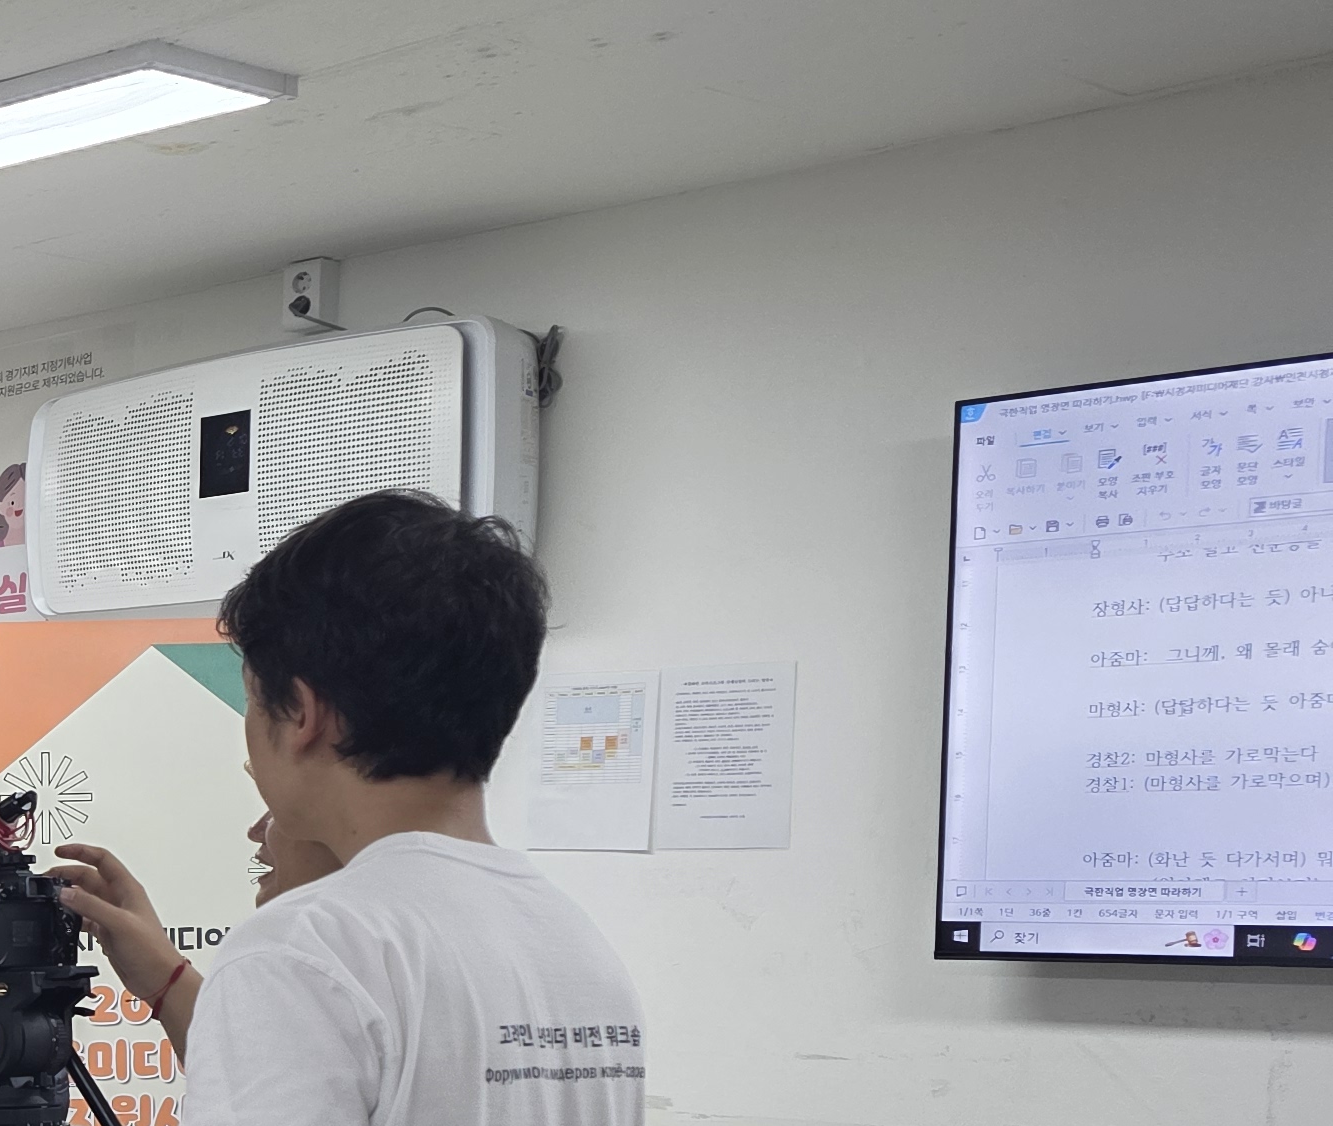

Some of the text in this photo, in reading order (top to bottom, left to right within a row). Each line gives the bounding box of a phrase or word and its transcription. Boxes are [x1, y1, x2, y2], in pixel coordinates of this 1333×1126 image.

[40, 351, 93, 374] 지정기탁사업
[1158, 591, 1255, 614] (답답하다는
[1264, 588, 1291, 607] 듯)
[1090, 649, 1149, 667] 아줌마:
[1235, 642, 1253, 660] 왜
[1263, 639, 1301, 659] 몰래
[1310, 638, 1333, 656] 숨
[1088, 699, 1146, 718] 마형사:
[1260, 694, 1279, 712] 듯
[1085, 745, 1318, 768] 경찰2: 마형사를 가로막는다
[1085, 776, 1135, 793] 경찰1:
[1230, 771, 1331, 790] 가로막으며)
[1082, 852, 1140, 869] 아줌마:
[1147, 851, 1190, 869] (화난
[1197, 852, 1217, 869] 듯
[1225, 850, 1308, 869] 다가서며)
[1084, 886, 1125, 898] 극한직업
[1160, 885, 1203, 898] 따라하기
[1097, 908, 1139, 919] 654글자
[1154, 908, 1175, 920] 문자
[1177, 908, 1199, 920] 입력
[572, 1024, 603, 1047] 비전
